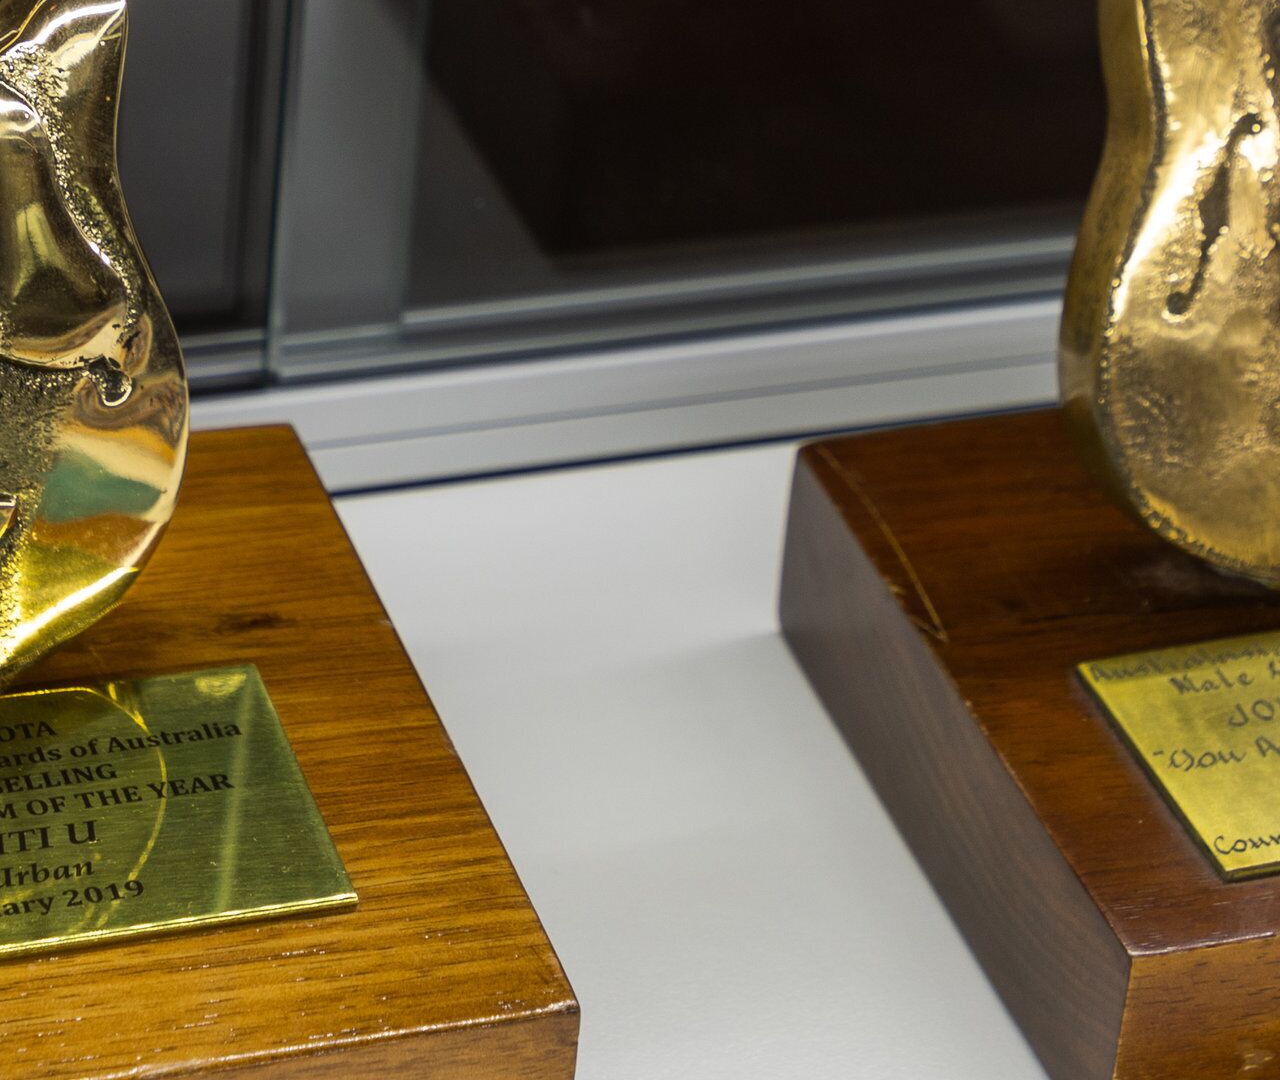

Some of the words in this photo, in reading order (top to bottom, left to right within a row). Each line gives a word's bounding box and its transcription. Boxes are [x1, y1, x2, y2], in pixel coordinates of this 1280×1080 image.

[1170, 670, 1254, 696] Male
[70, 739, 97, 758] of
[107, 722, 242, 753] Australia
[26, 796, 66, 816] OF
[74, 785, 143, 810] THE
[146, 772, 235, 800] YEAR
[65, 820, 100, 845] U
[62, 879, 145, 907] 2019
